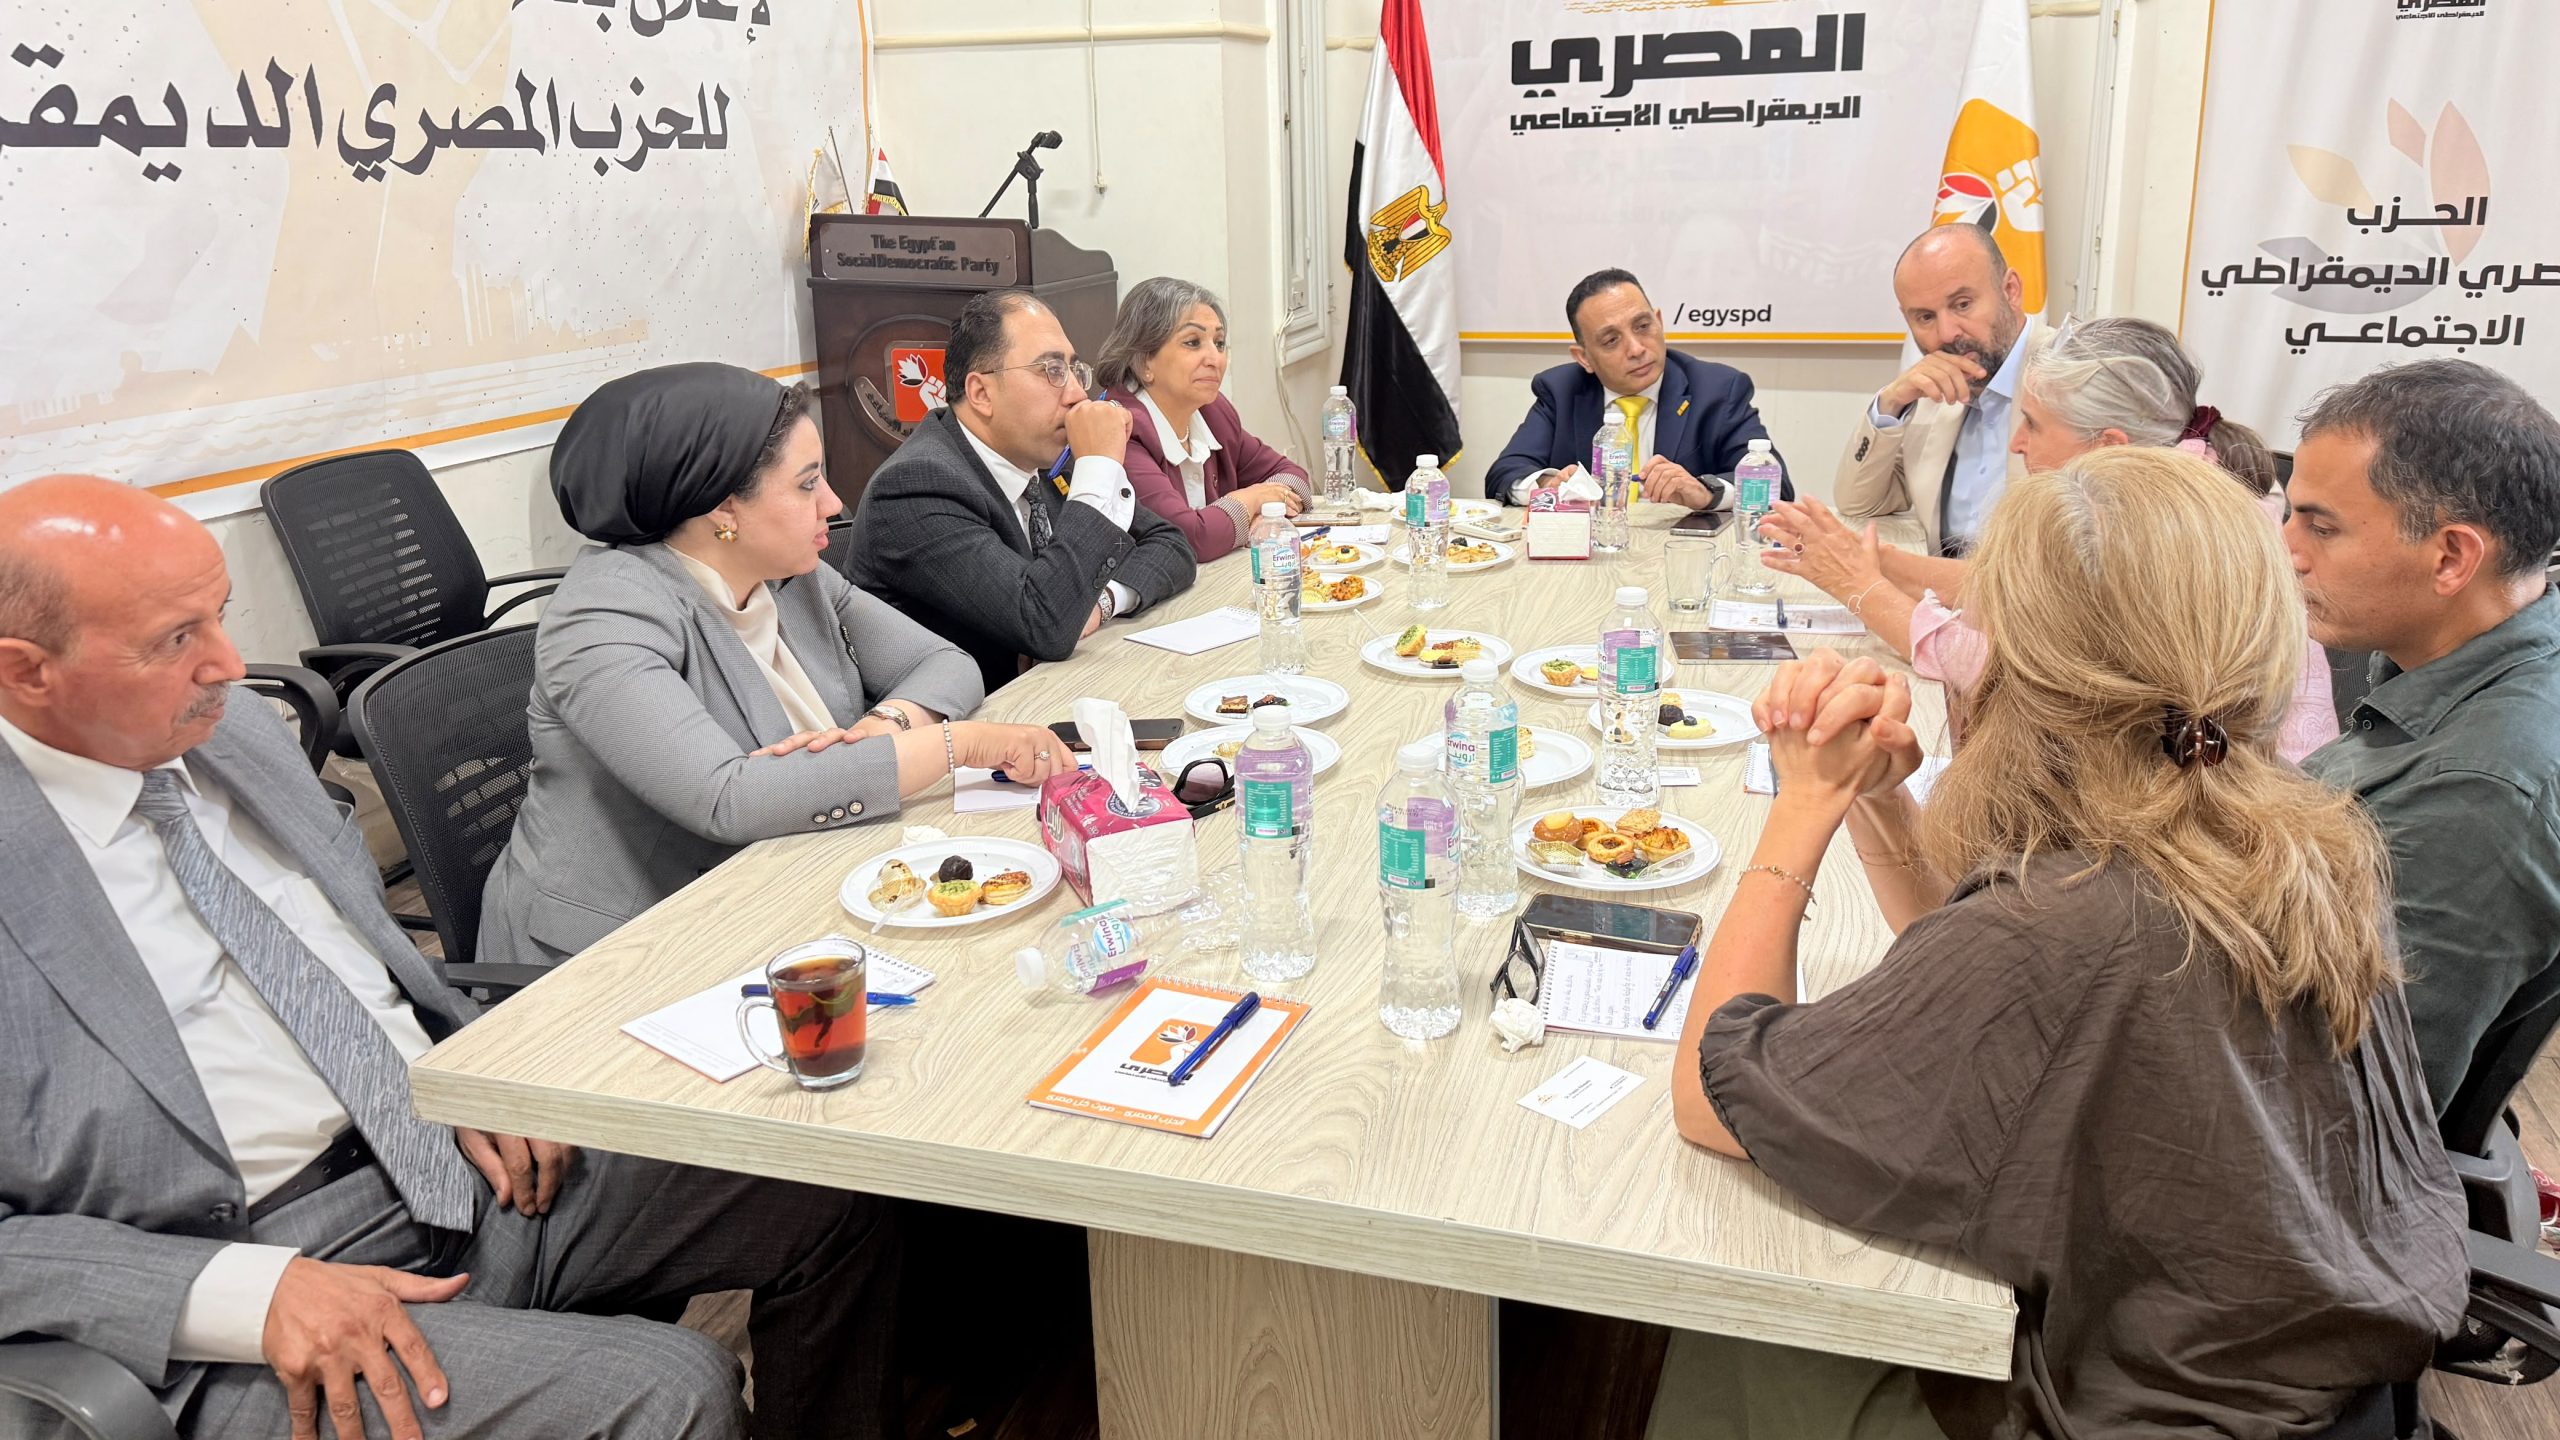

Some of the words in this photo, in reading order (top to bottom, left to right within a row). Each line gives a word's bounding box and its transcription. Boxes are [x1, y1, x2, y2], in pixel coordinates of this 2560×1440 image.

[1512, 13, 1866, 98] المصري
[0, 43, 323, 181] الديمق
[338, 69, 561, 182] المصري
[570, 77, 730, 176] للحزب
[1510, 103, 1661, 136] الاجتماعي
[1669, 95, 1861, 130] الديمقراطي
[2347, 196, 2489, 234] الحزب
[899, 235, 956, 254] Egyptan
[2201, 257, 2450, 297] الديمقراطي
[1688, 303, 1772, 327] egyspd
[2285, 315, 2525, 354] الاجتماعي
[1272, 553, 1296, 562] Erwina
[1098, 918, 1117, 958] Erwina
